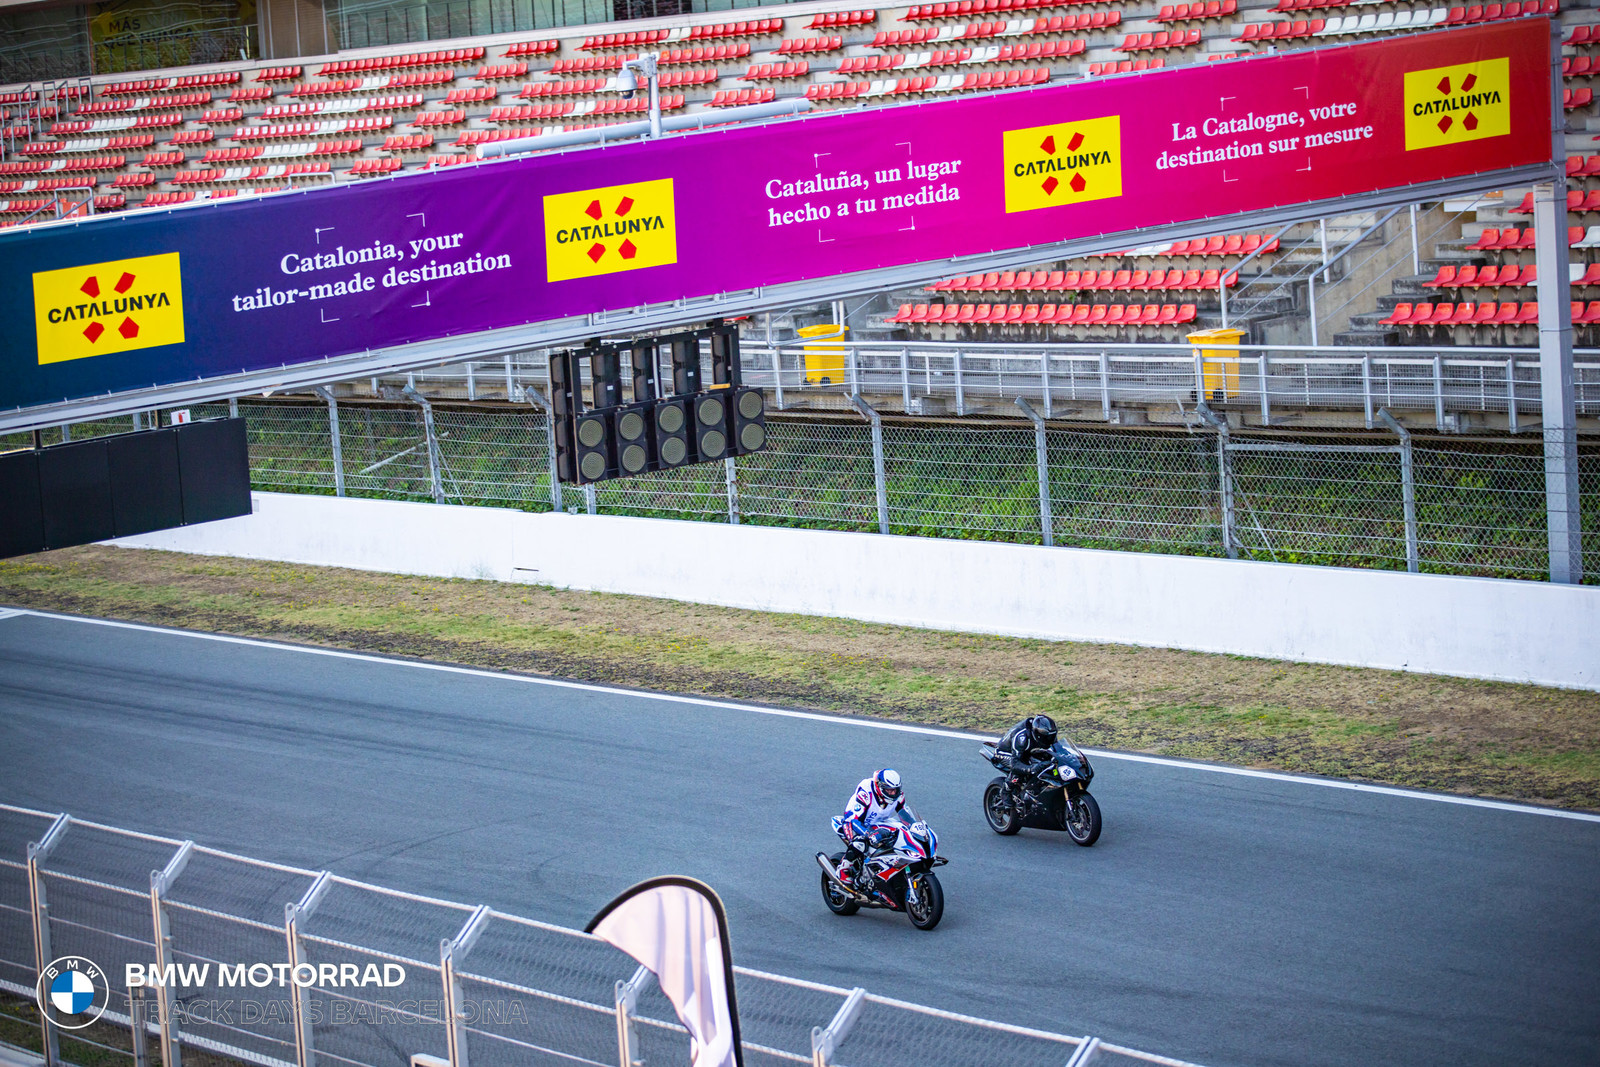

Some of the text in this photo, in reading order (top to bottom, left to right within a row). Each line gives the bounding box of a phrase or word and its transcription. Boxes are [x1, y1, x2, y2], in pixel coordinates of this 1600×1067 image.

[109, 16, 141, 33] MÁS
[1171, 102, 1357, 142] La Catalogne, votre
[1413, 90, 1502, 117] CATALUNYA
[1014, 150, 1111, 177] CATALUNYA
[1155, 125, 1373, 170] destination sur mesure
[765, 158, 963, 199] Cataluña, un lugar
[767, 183, 961, 227] hecho a tu medida
[556, 215, 665, 244] CATALUNYA
[280, 231, 464, 275] Catalonia, your
[232, 252, 512, 312] tailor-made destination
[48, 292, 170, 324] CATALUNYA
